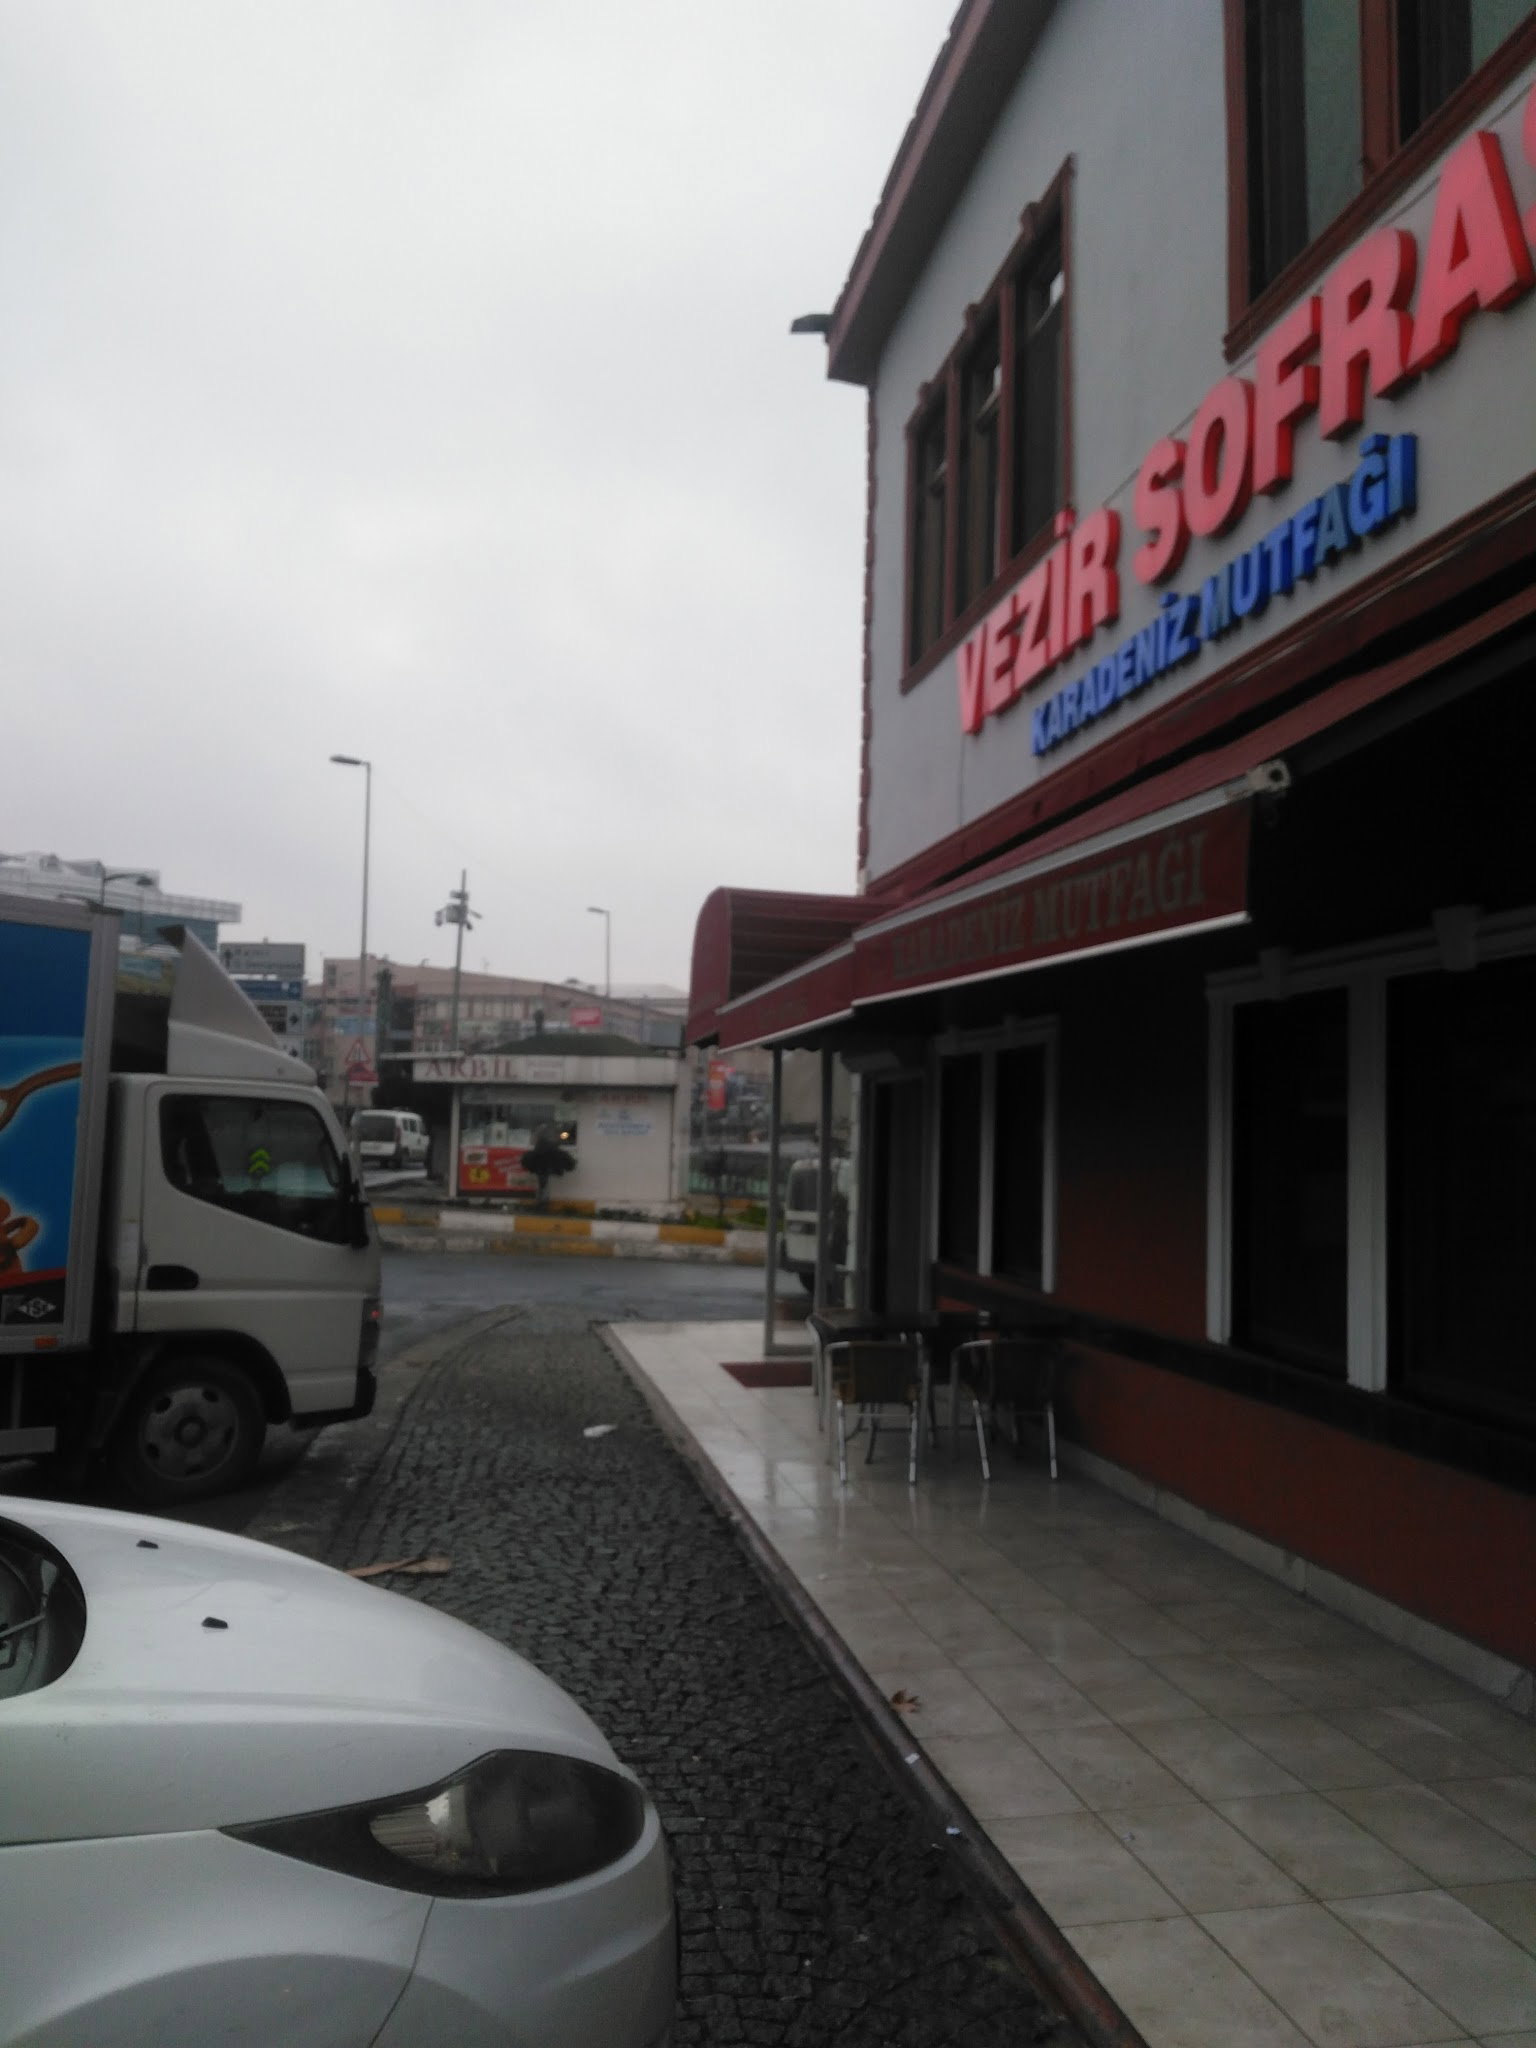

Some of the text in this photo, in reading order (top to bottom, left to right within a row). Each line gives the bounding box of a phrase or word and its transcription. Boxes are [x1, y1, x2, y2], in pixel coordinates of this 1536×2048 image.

[957, 79, 1536, 735] VEZİR SOFRA
[1030, 432, 1418, 757] KARADENİZ MUTFAĞI
